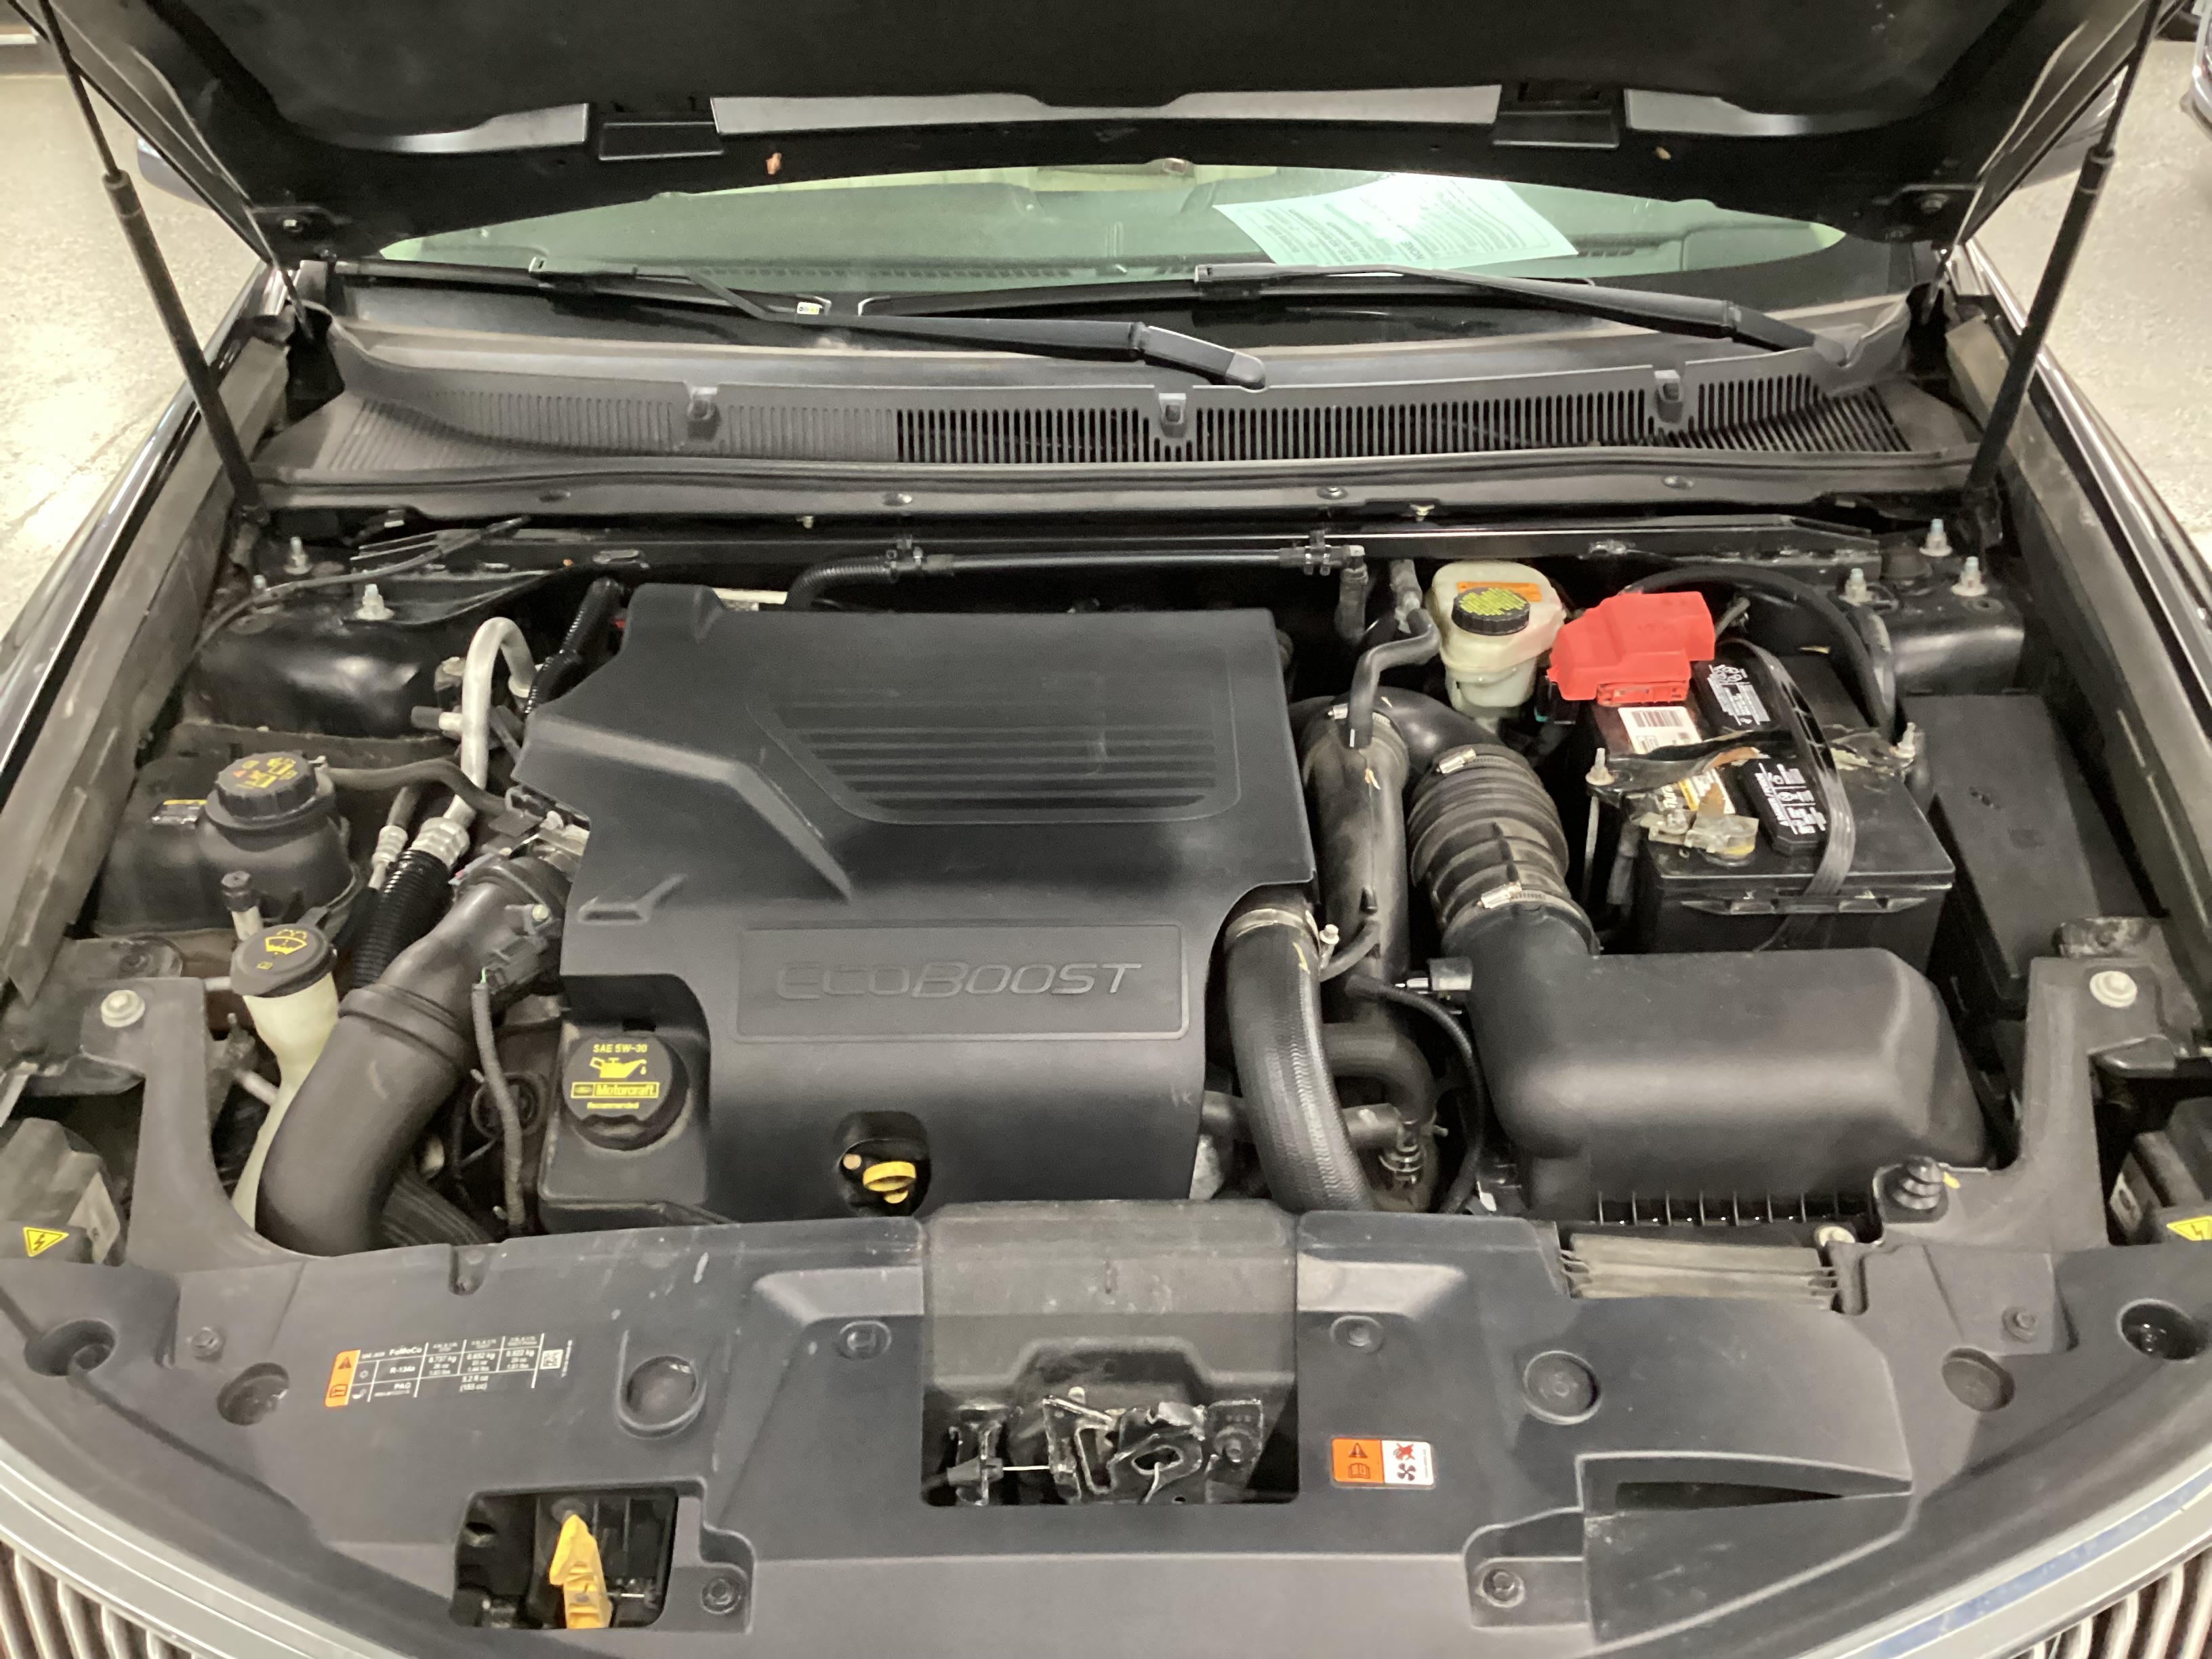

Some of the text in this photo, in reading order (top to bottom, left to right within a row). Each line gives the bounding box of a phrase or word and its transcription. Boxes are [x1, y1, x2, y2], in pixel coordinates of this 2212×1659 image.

[593, 1044, 648, 1053] SAE 5W-30
[596, 1084, 655, 1096] Motorcraft
[394, 1382, 412, 1390] PAG
